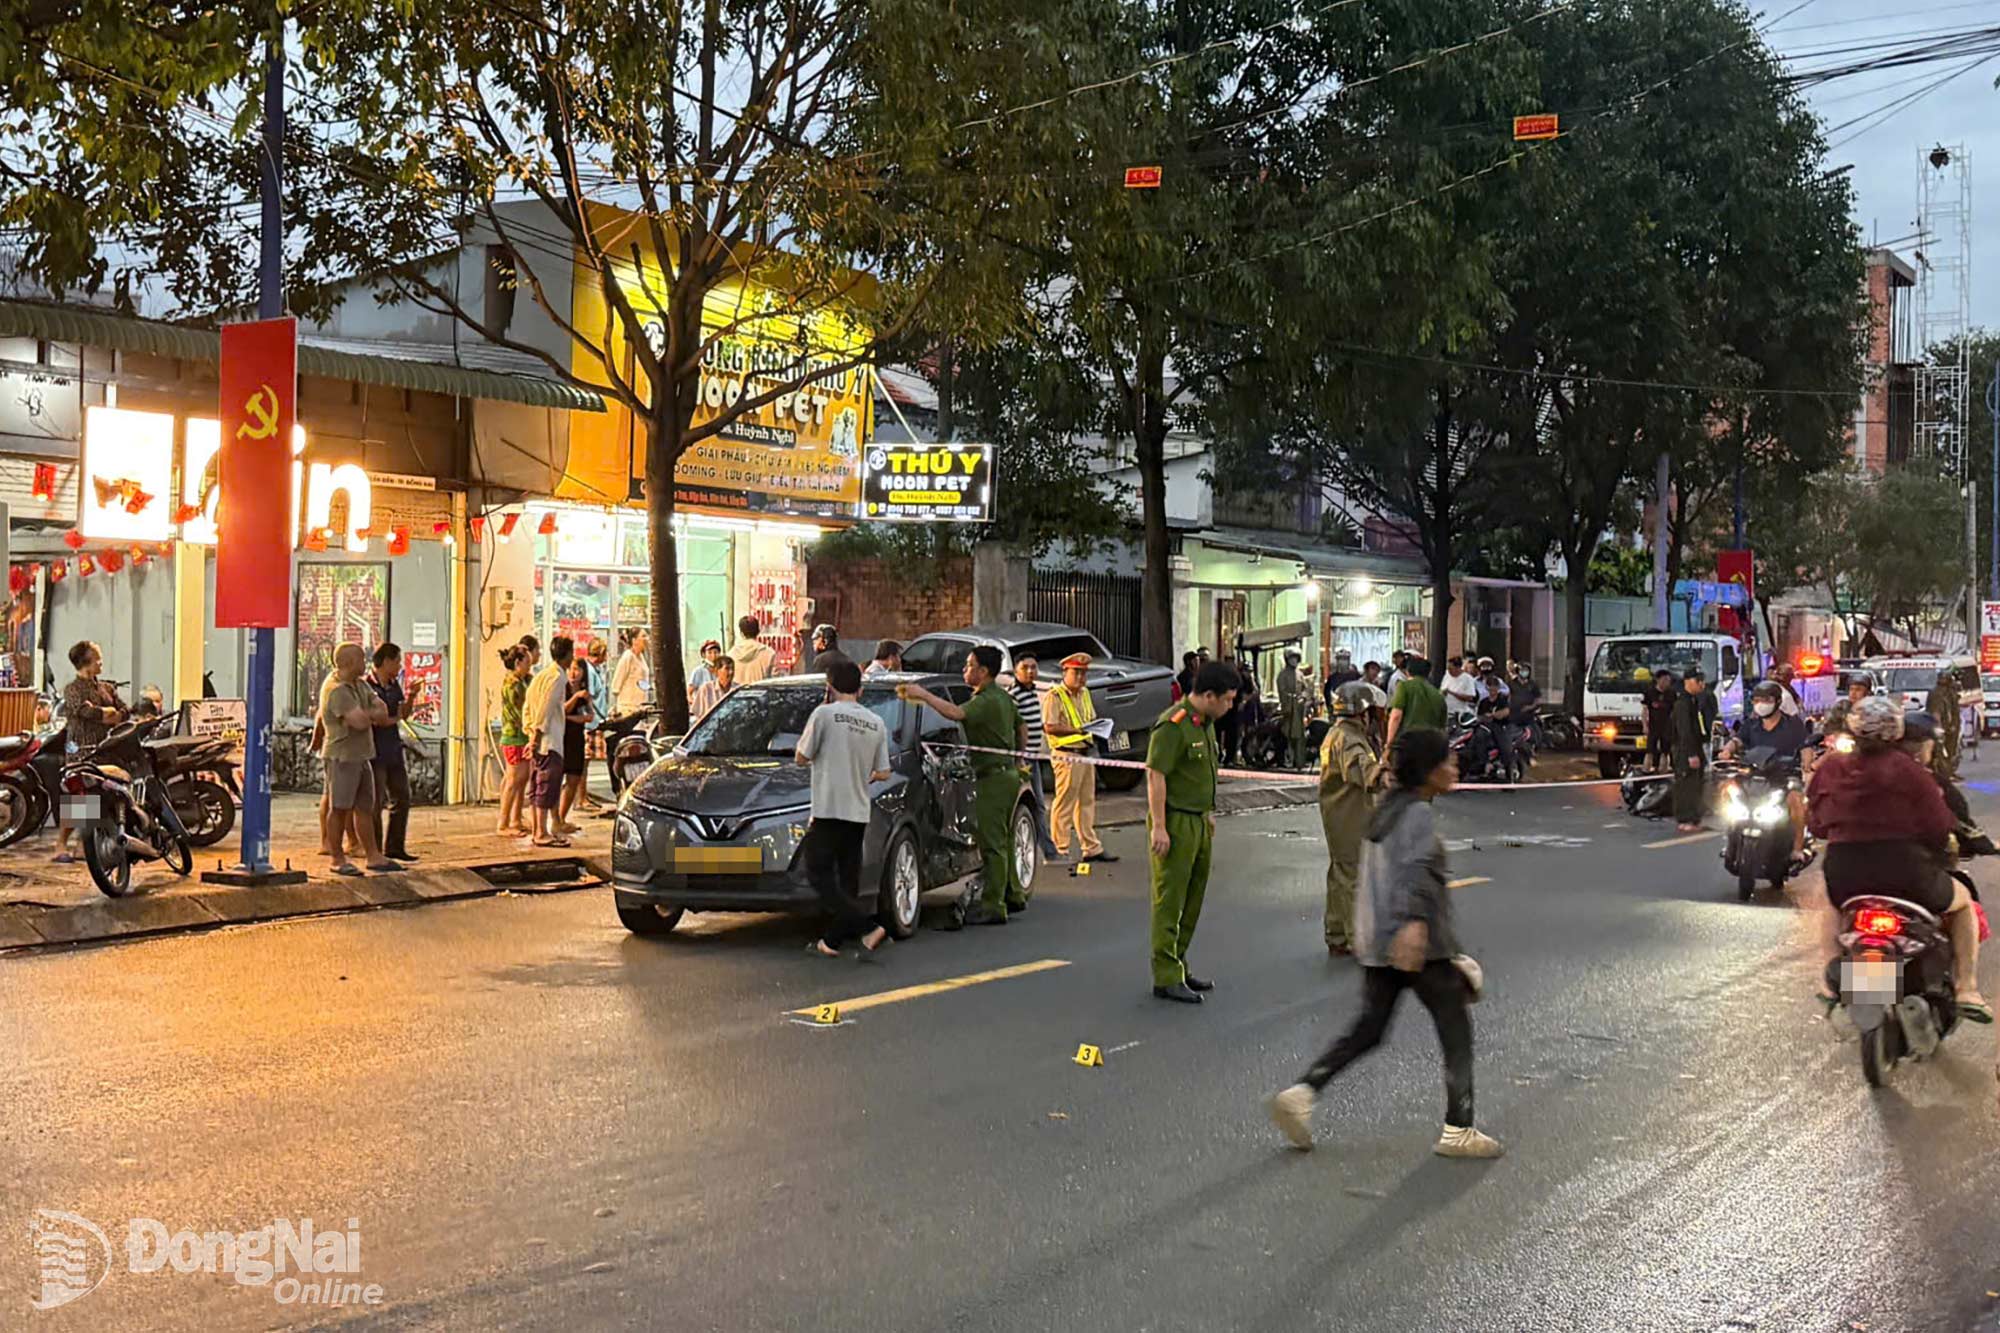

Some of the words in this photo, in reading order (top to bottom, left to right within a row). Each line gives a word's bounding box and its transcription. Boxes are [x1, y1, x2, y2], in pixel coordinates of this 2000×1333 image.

[774, 392, 829, 426] PET
[887, 448, 953, 474] THÚ
[958, 452, 982, 474] Y
[881, 475, 929, 490] MOON
[935, 476, 972, 491] PET
[822, 1006, 830, 1020] 2
[1082, 1048, 1091, 1061] 3
